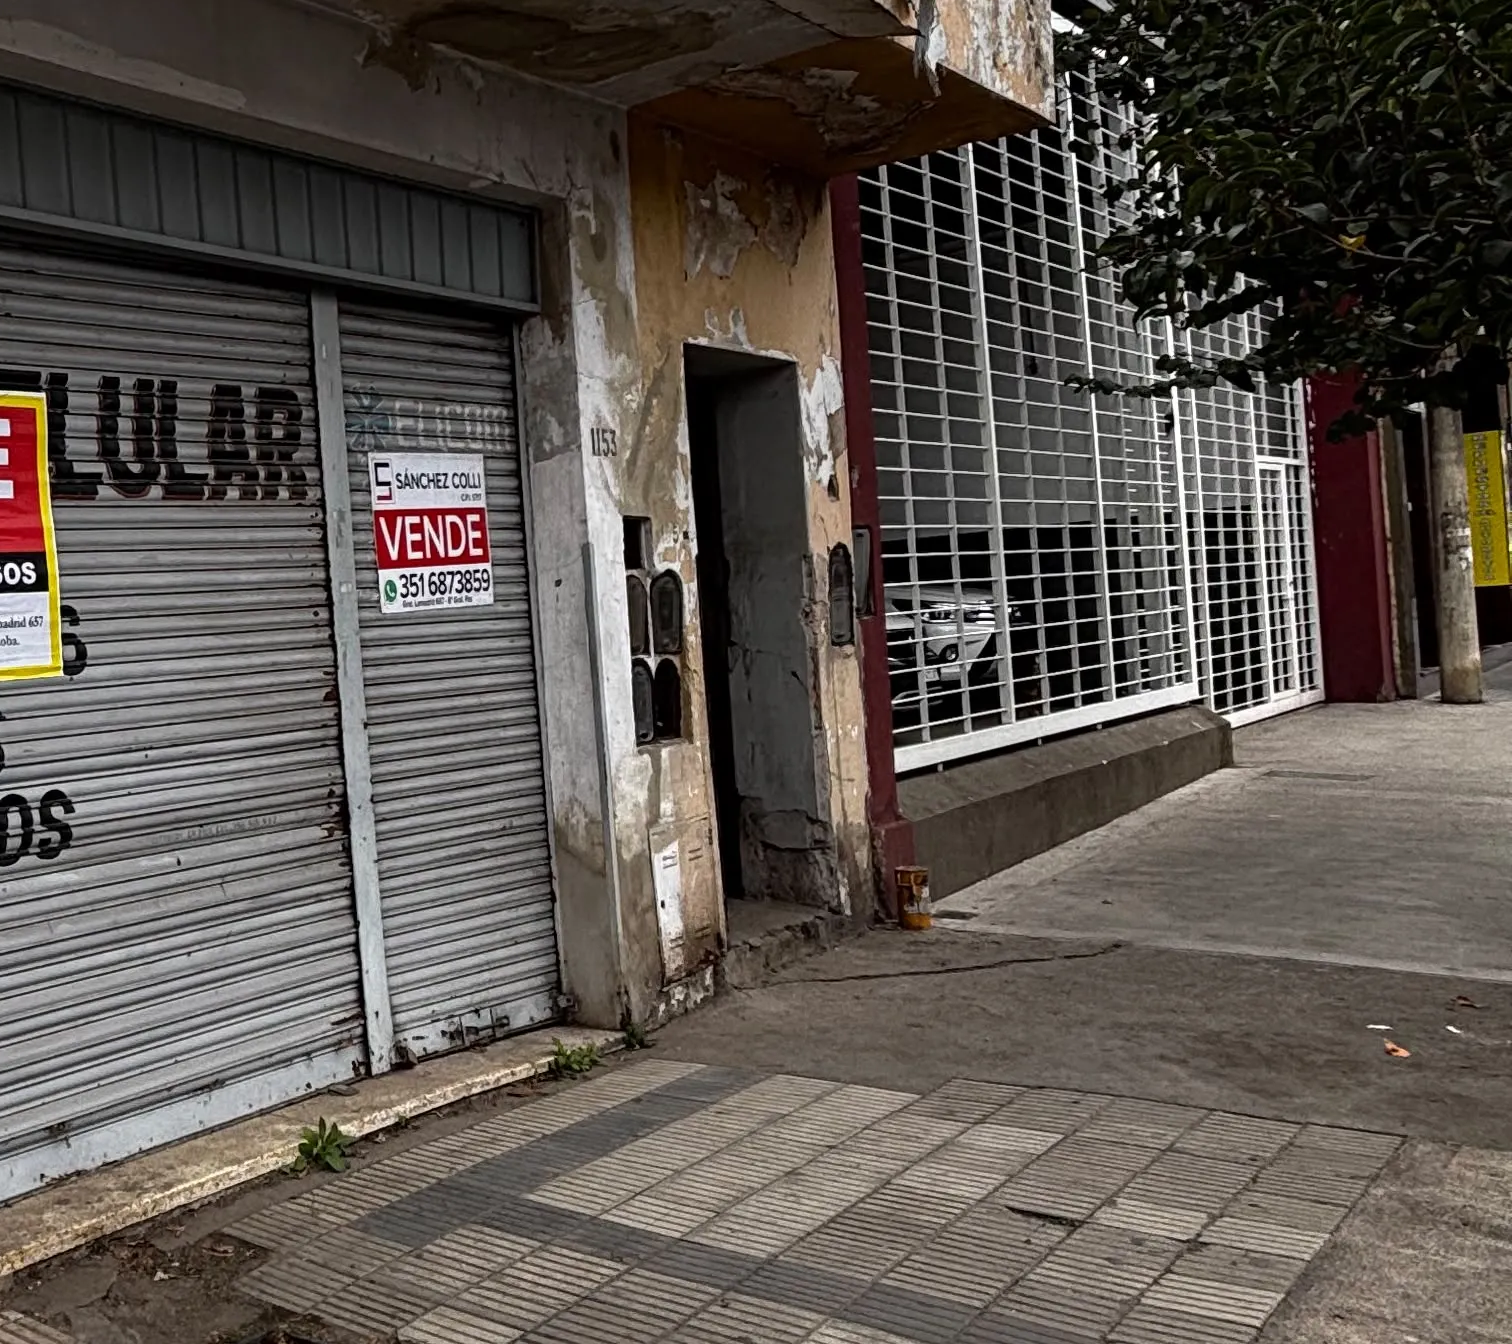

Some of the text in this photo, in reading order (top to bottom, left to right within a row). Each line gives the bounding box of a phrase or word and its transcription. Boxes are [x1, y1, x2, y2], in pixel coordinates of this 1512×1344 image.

[590, 427, 618, 457] 1153
[395, 467, 482, 490] SÁNCHEZ COLLI
[378, 514, 484, 561] VENDE
[399, 568, 491, 599] 351 6873859
[28, 615, 44, 628] 657
